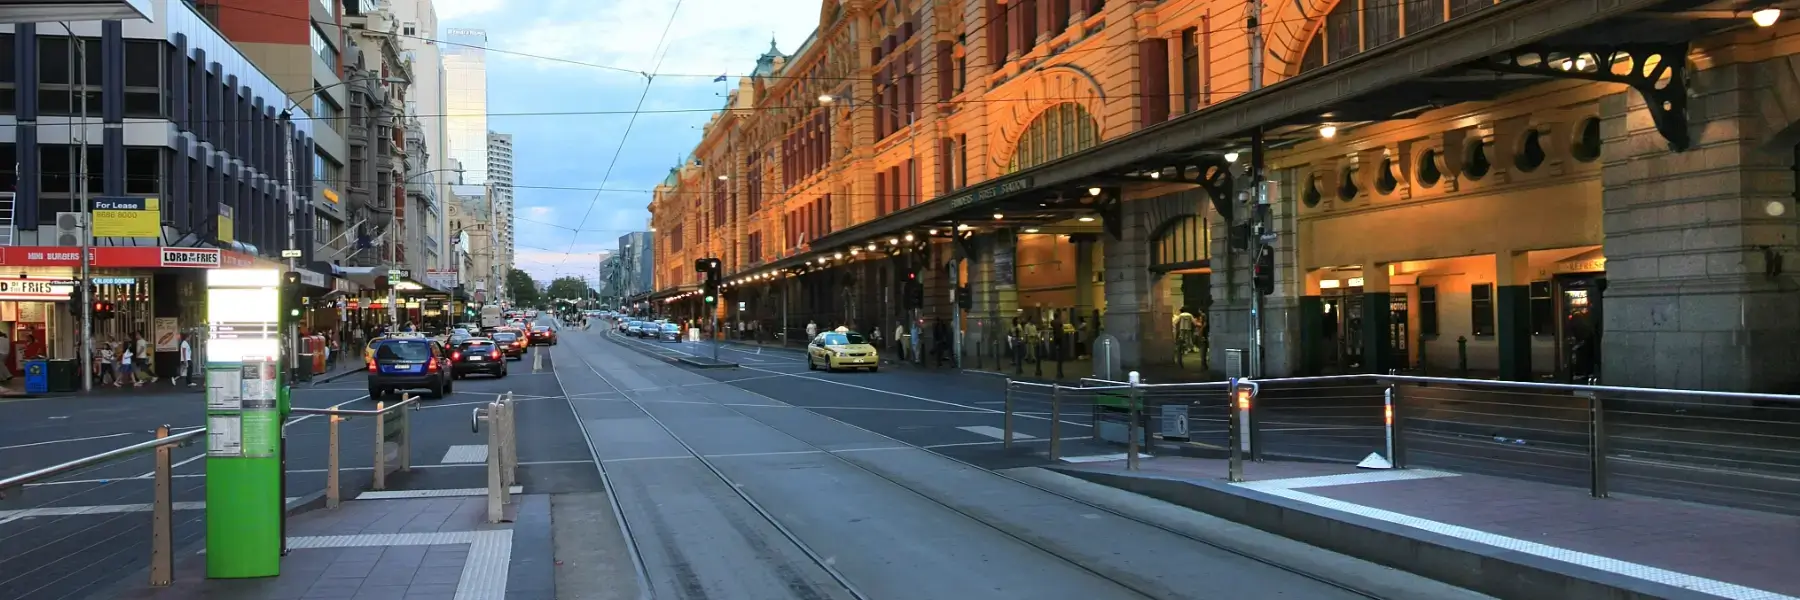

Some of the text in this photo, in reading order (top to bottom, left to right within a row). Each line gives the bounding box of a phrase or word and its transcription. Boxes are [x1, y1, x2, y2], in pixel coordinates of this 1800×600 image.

[96, 201, 138, 209] For Lease
[46, 252, 80, 261] BURGERS
[164, 251, 188, 262] LORD
[196, 252, 218, 263] FRIES
[22, 282, 52, 293] FRIES
